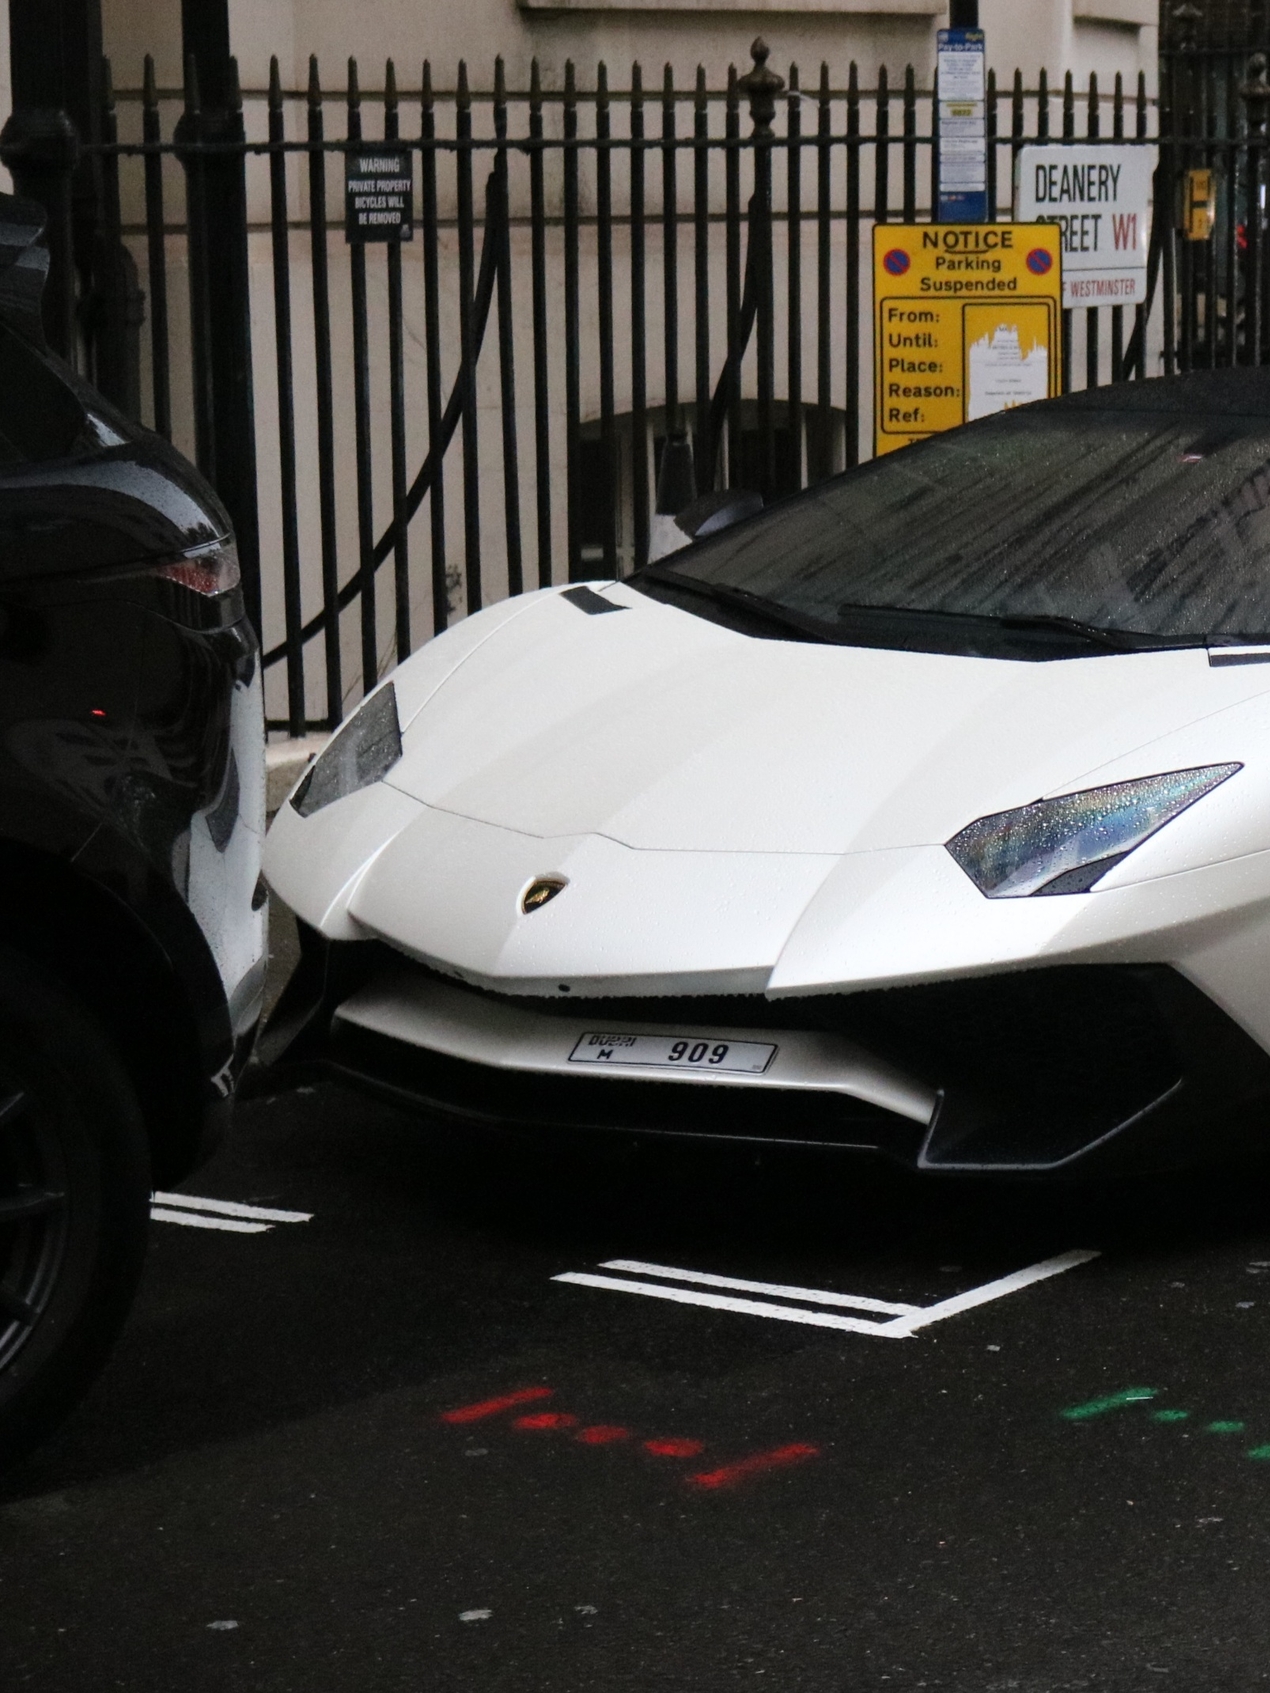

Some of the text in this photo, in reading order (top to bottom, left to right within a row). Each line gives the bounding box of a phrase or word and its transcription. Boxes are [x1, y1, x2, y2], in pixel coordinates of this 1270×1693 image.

[360, 158, 400, 173] WARNING
[348, 179, 411, 193] PRIVATE PROPERTY
[1035, 164, 1121, 203] DEANERY
[355, 195, 405, 209] BICYCLES WILL
[358, 211, 401, 225] BE REMOVED
[922, 230, 1014, 250] NOTICE
[1036, 213, 1137, 252] REET W1
[935, 256, 1002, 273] Parking
[920, 277, 1018, 294] Suspended
[1070, 278, 1136, 298] WESTMINSTER
[888, 307, 940, 324] From:
[888, 332, 938, 348] Until:
[888, 358, 943, 373] Place:
[888, 383, 961, 398] Reason:
[888, 407, 925, 423] Ref:
[596, 1049, 614, 1060] M
[668, 1041, 729, 1065] 909
